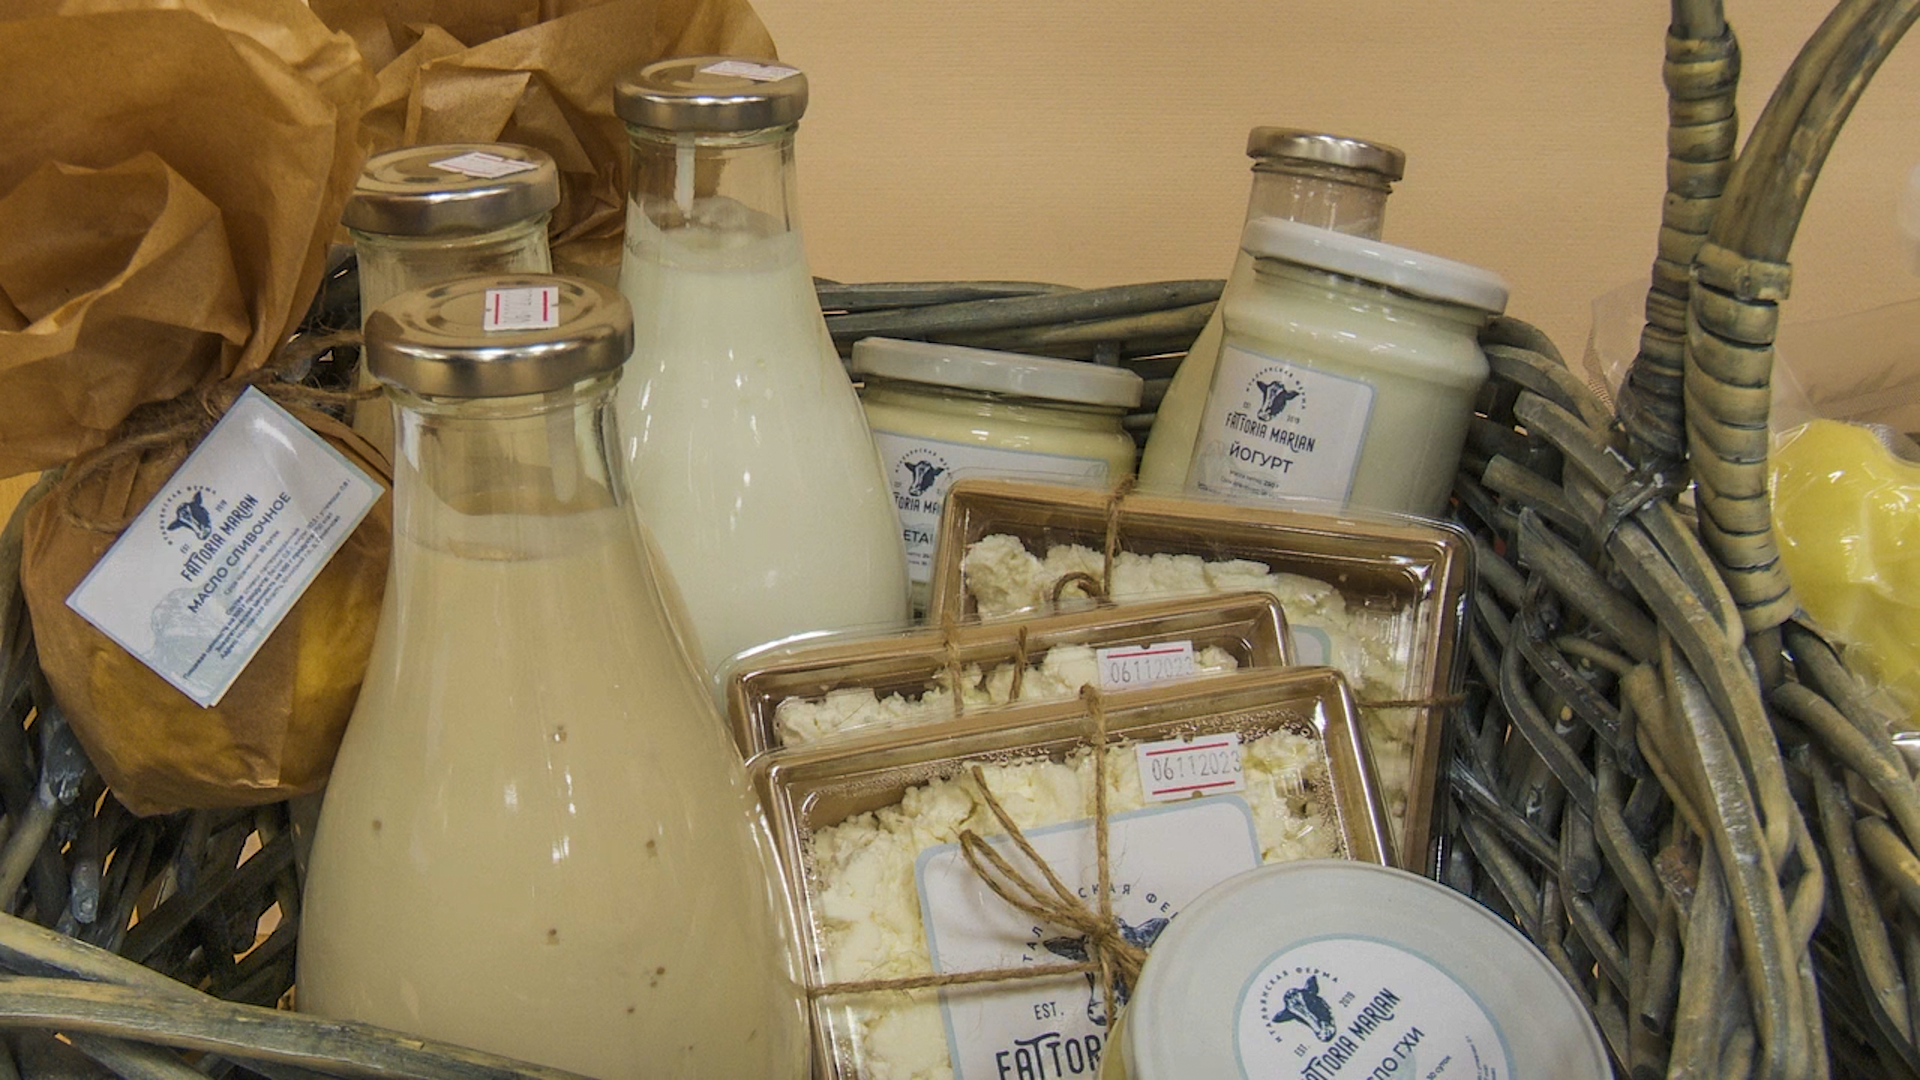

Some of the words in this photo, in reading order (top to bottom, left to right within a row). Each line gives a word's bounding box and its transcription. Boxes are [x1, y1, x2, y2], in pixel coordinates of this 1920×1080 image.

[1225, 411, 1267, 438] FATTORIA
[1269, 427, 1316, 453] MARIAN
[1229, 440, 1293, 473] ЙОГУРТ
[180, 532, 226, 582] FATTORIA
[219, 493, 259, 536] MARIAN
[187, 566, 229, 613] МАСЛО
[226, 491, 292, 567] СЛИВОЧНОЕ
[903, 529, 934, 545] ЕТА
[1145, 892, 1178, 919] ФЕ
[1296, 966, 1338, 984] ФЕРМА
[1034, 1002, 1064, 1020] EST.
[1347, 987, 1401, 1041] MARIAN
[996, 1032, 1108, 1080] FATTOR
[1392, 1026, 1426, 1060] ГХИ
